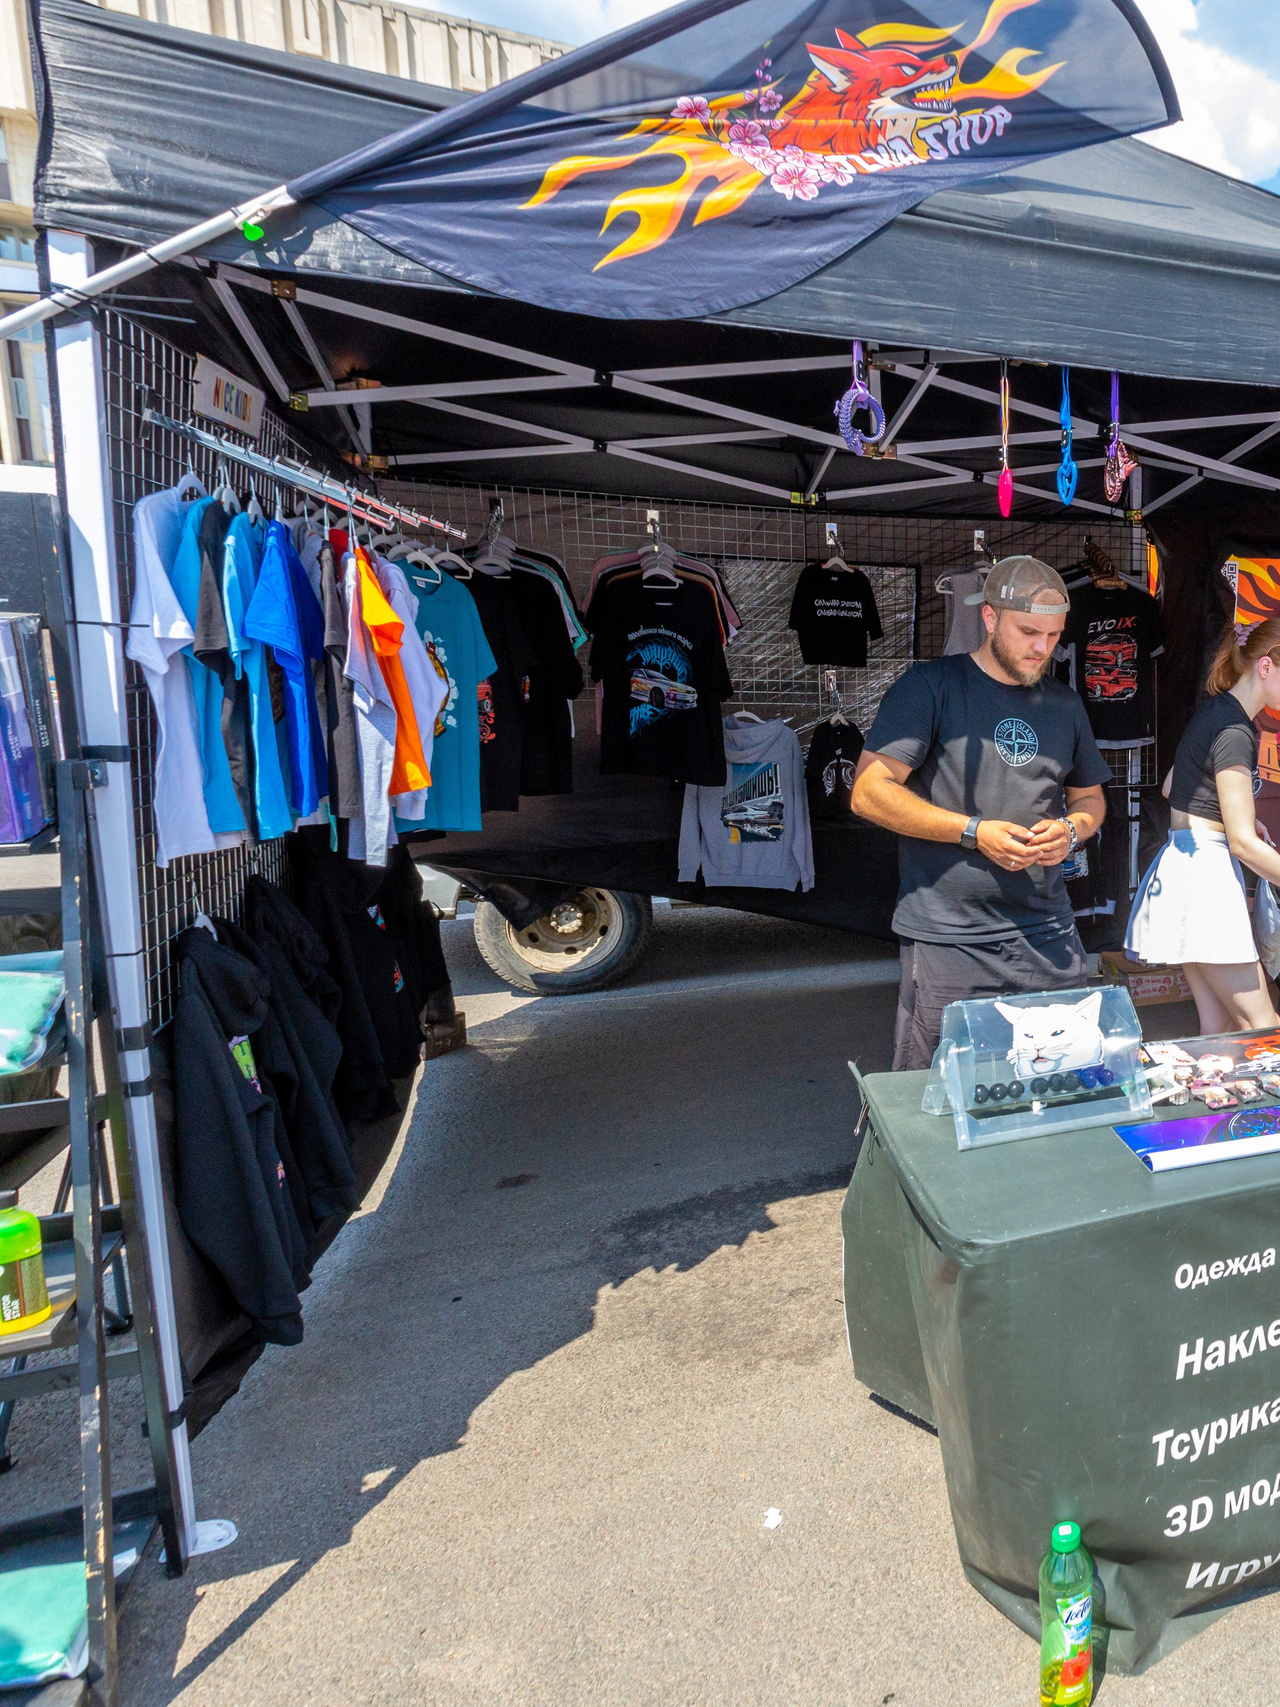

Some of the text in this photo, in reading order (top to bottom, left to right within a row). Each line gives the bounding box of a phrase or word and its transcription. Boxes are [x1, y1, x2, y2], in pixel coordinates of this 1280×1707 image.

[825, 104, 1013, 176] JLKA SHOP
[213, 376, 254, 424] NICE KIDS
[1088, 618, 1117, 634] EVO
[997, 720, 1036, 763] STONE ISLAND STONE ISLAND
[1174, 1246, 1277, 1290] Одежда
[1, 1294, 12, 1322] MOTOR
[11, 1299, 21, 1319] STAR
[1163, 1495, 1214, 1538] 3D
